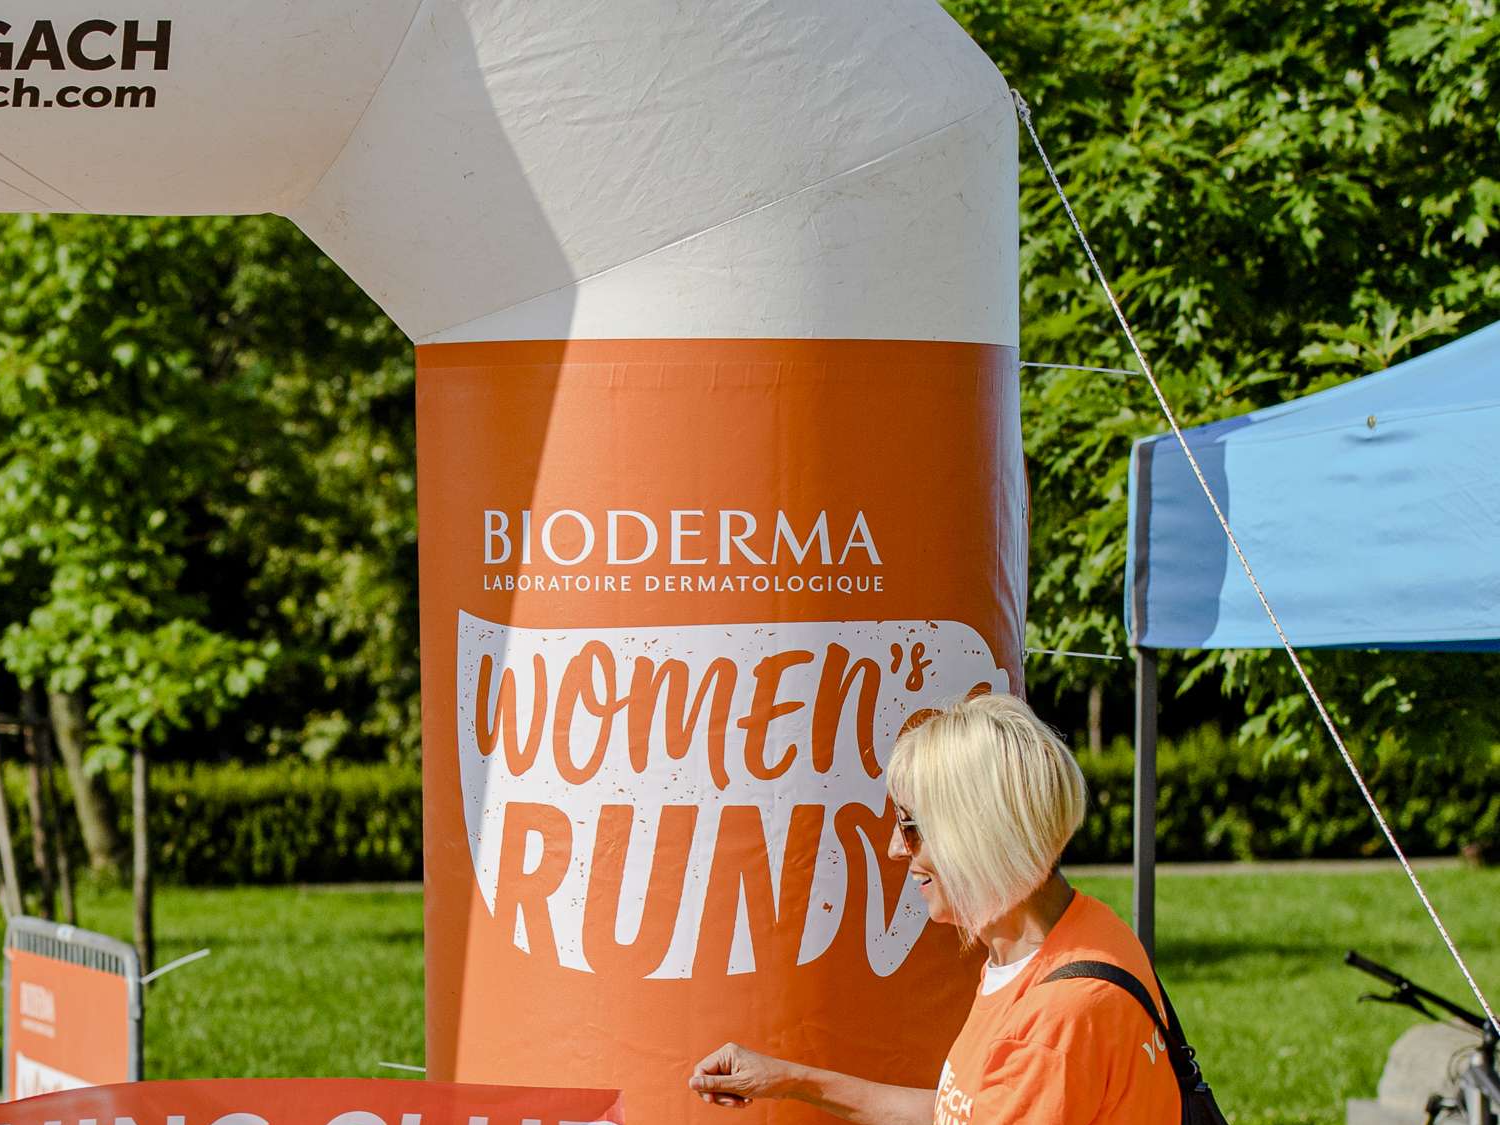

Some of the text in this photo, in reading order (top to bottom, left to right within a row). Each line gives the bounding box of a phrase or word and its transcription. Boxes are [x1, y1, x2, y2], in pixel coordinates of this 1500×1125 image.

[483, 509, 883, 566] BIODERMA
[483, 574, 884, 595] LABORATOIRE DERMATOLOGIQUE
